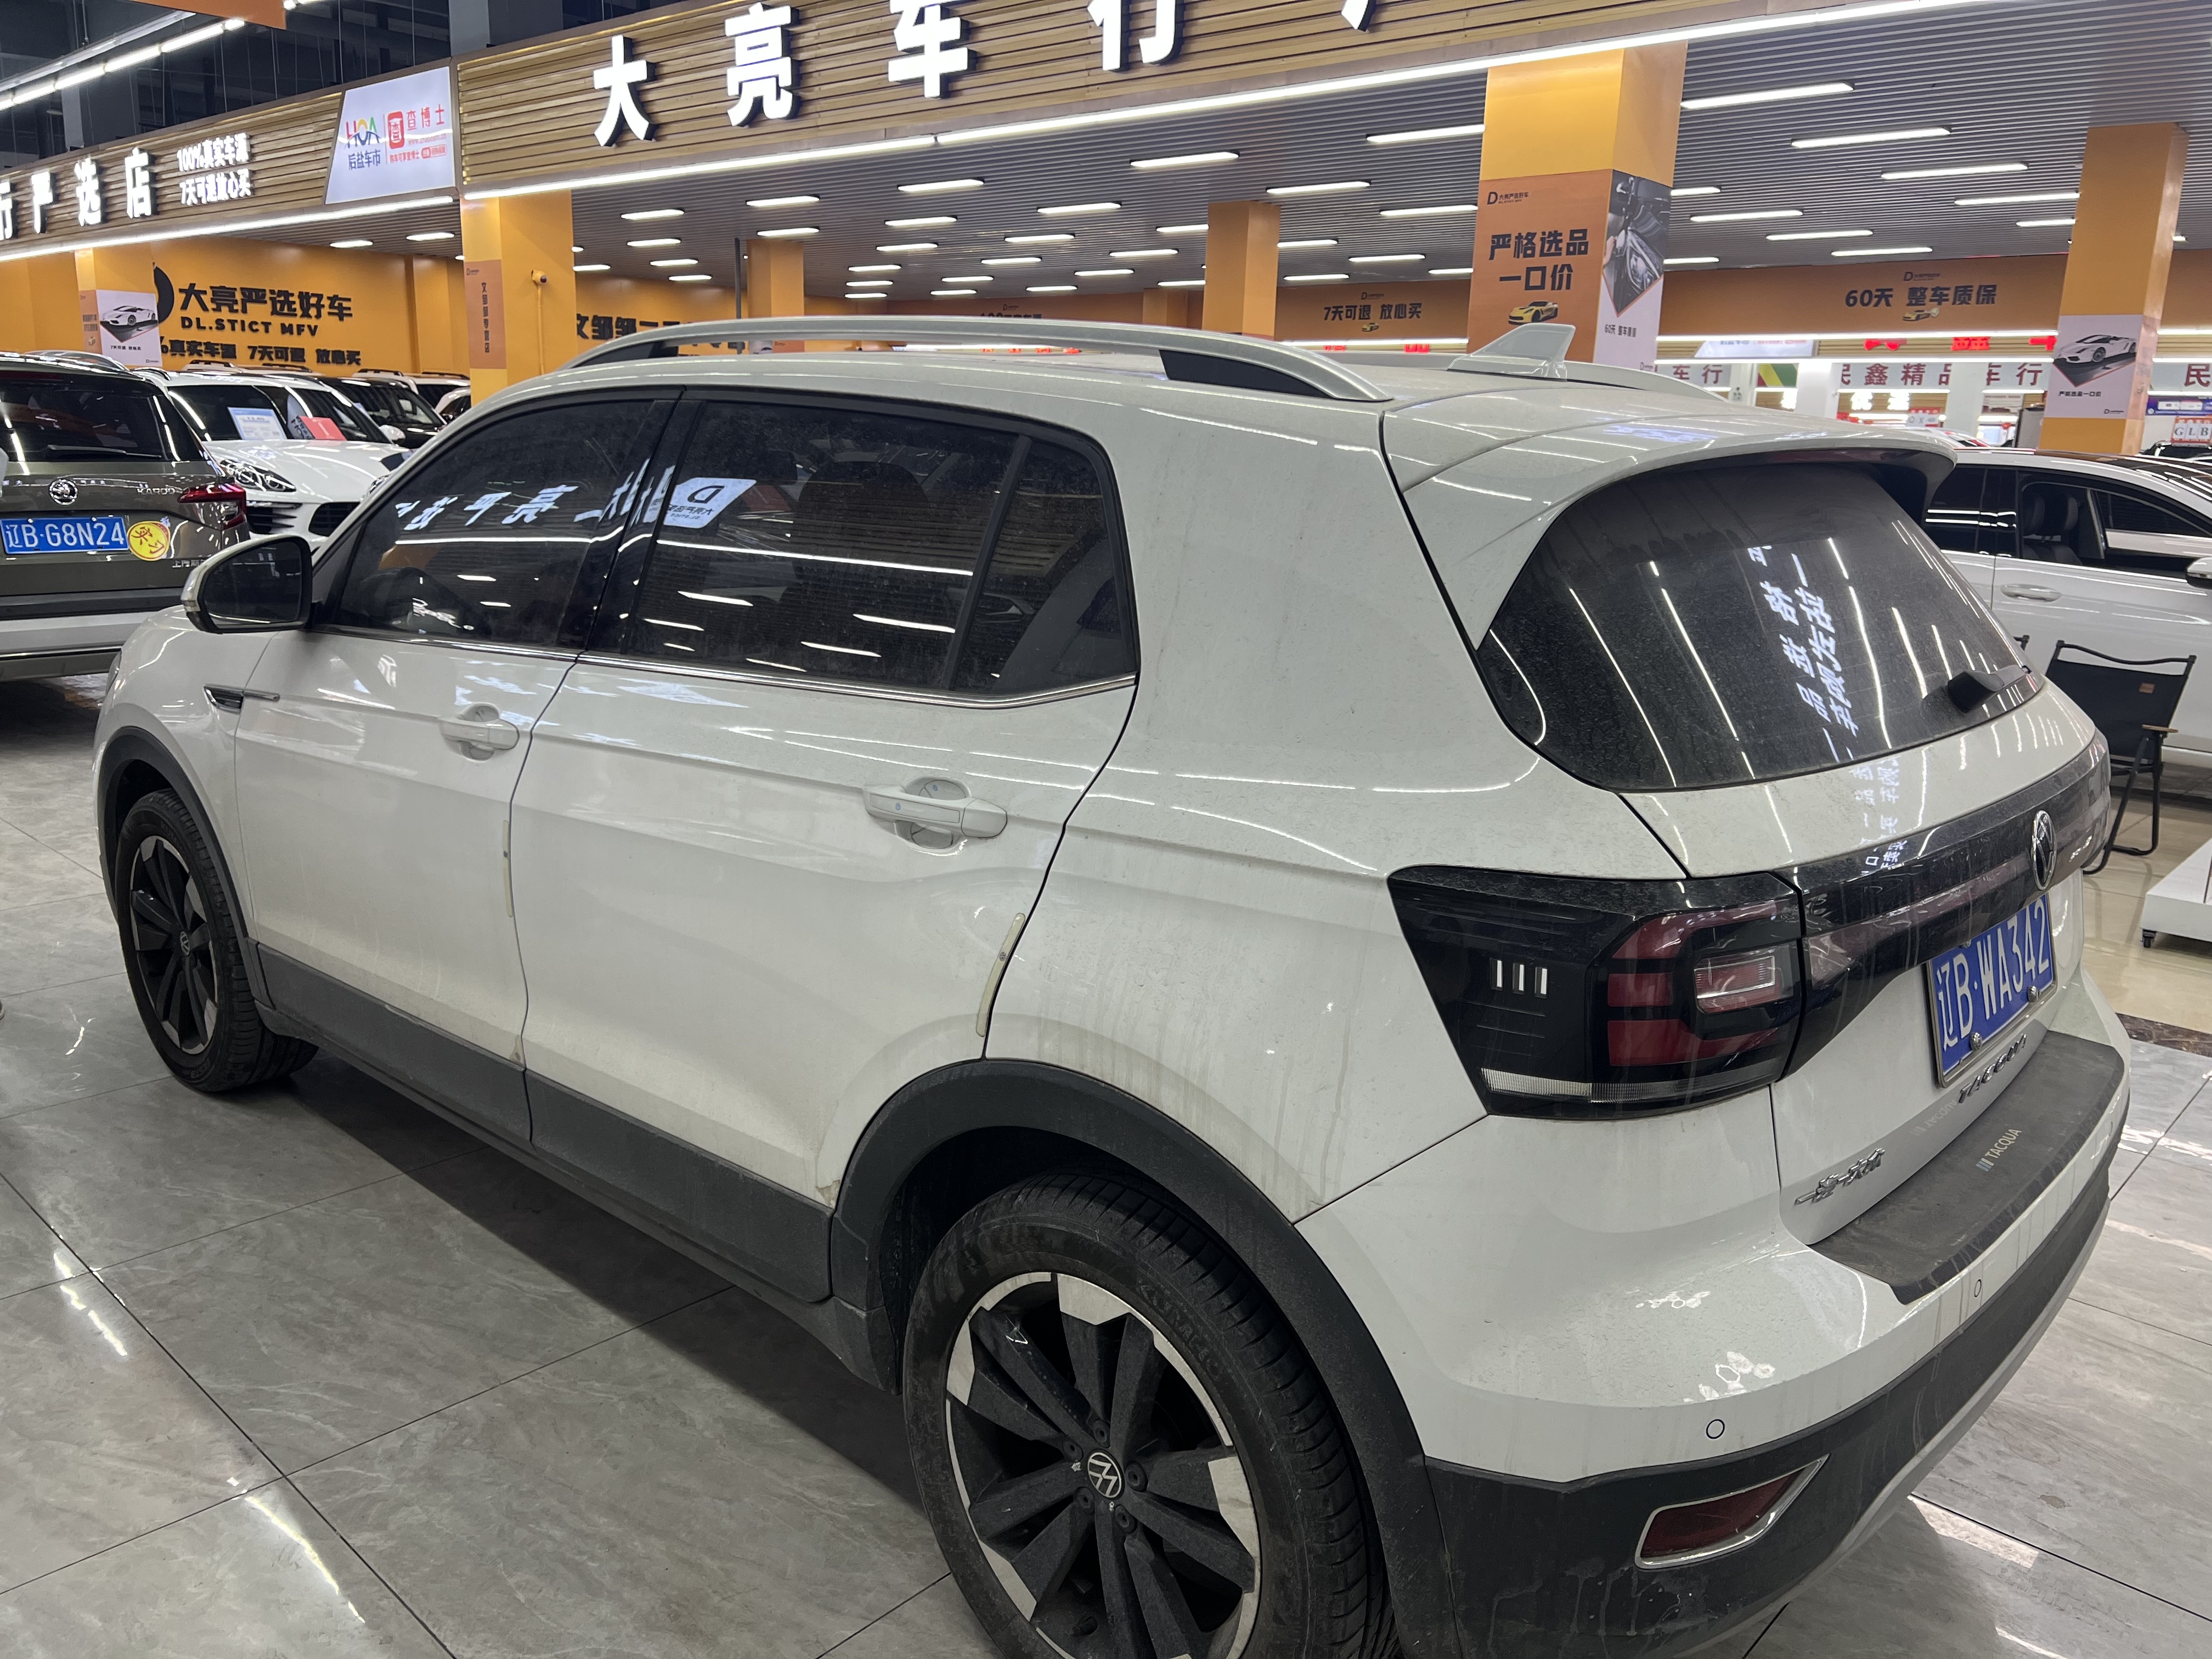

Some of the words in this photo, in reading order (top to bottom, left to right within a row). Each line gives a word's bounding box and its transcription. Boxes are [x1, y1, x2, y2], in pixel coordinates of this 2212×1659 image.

[593, 0, 1369, 147] 大亮车行
[407, 104, 444, 131] 查博士
[177, 132, 250, 172] 100%真实车源
[348, 149, 381, 170] 后盐车市
[1489, 229, 1589, 261] 严格选品
[1499, 264, 1573, 291] 一口价
[179, 283, 353, 321] 大亮严选好车
[1845, 288, 1893, 307] 60天
[1906, 285, 1997, 306] 整车质保
[1324, 305, 1370, 320] 7天可退
[1380, 303, 1422, 320] 放心买
[180, 317, 272, 333] DL.STICT
[281, 323, 318, 336] MFV
[248, 346, 306, 363] 7天可退
[316, 349, 361, 365] 放心买
[2184, 363, 2211, 387] 民
[2175, 427, 2209, 437] GLB
[1985, 1128, 2023, 1159] TACQUA
